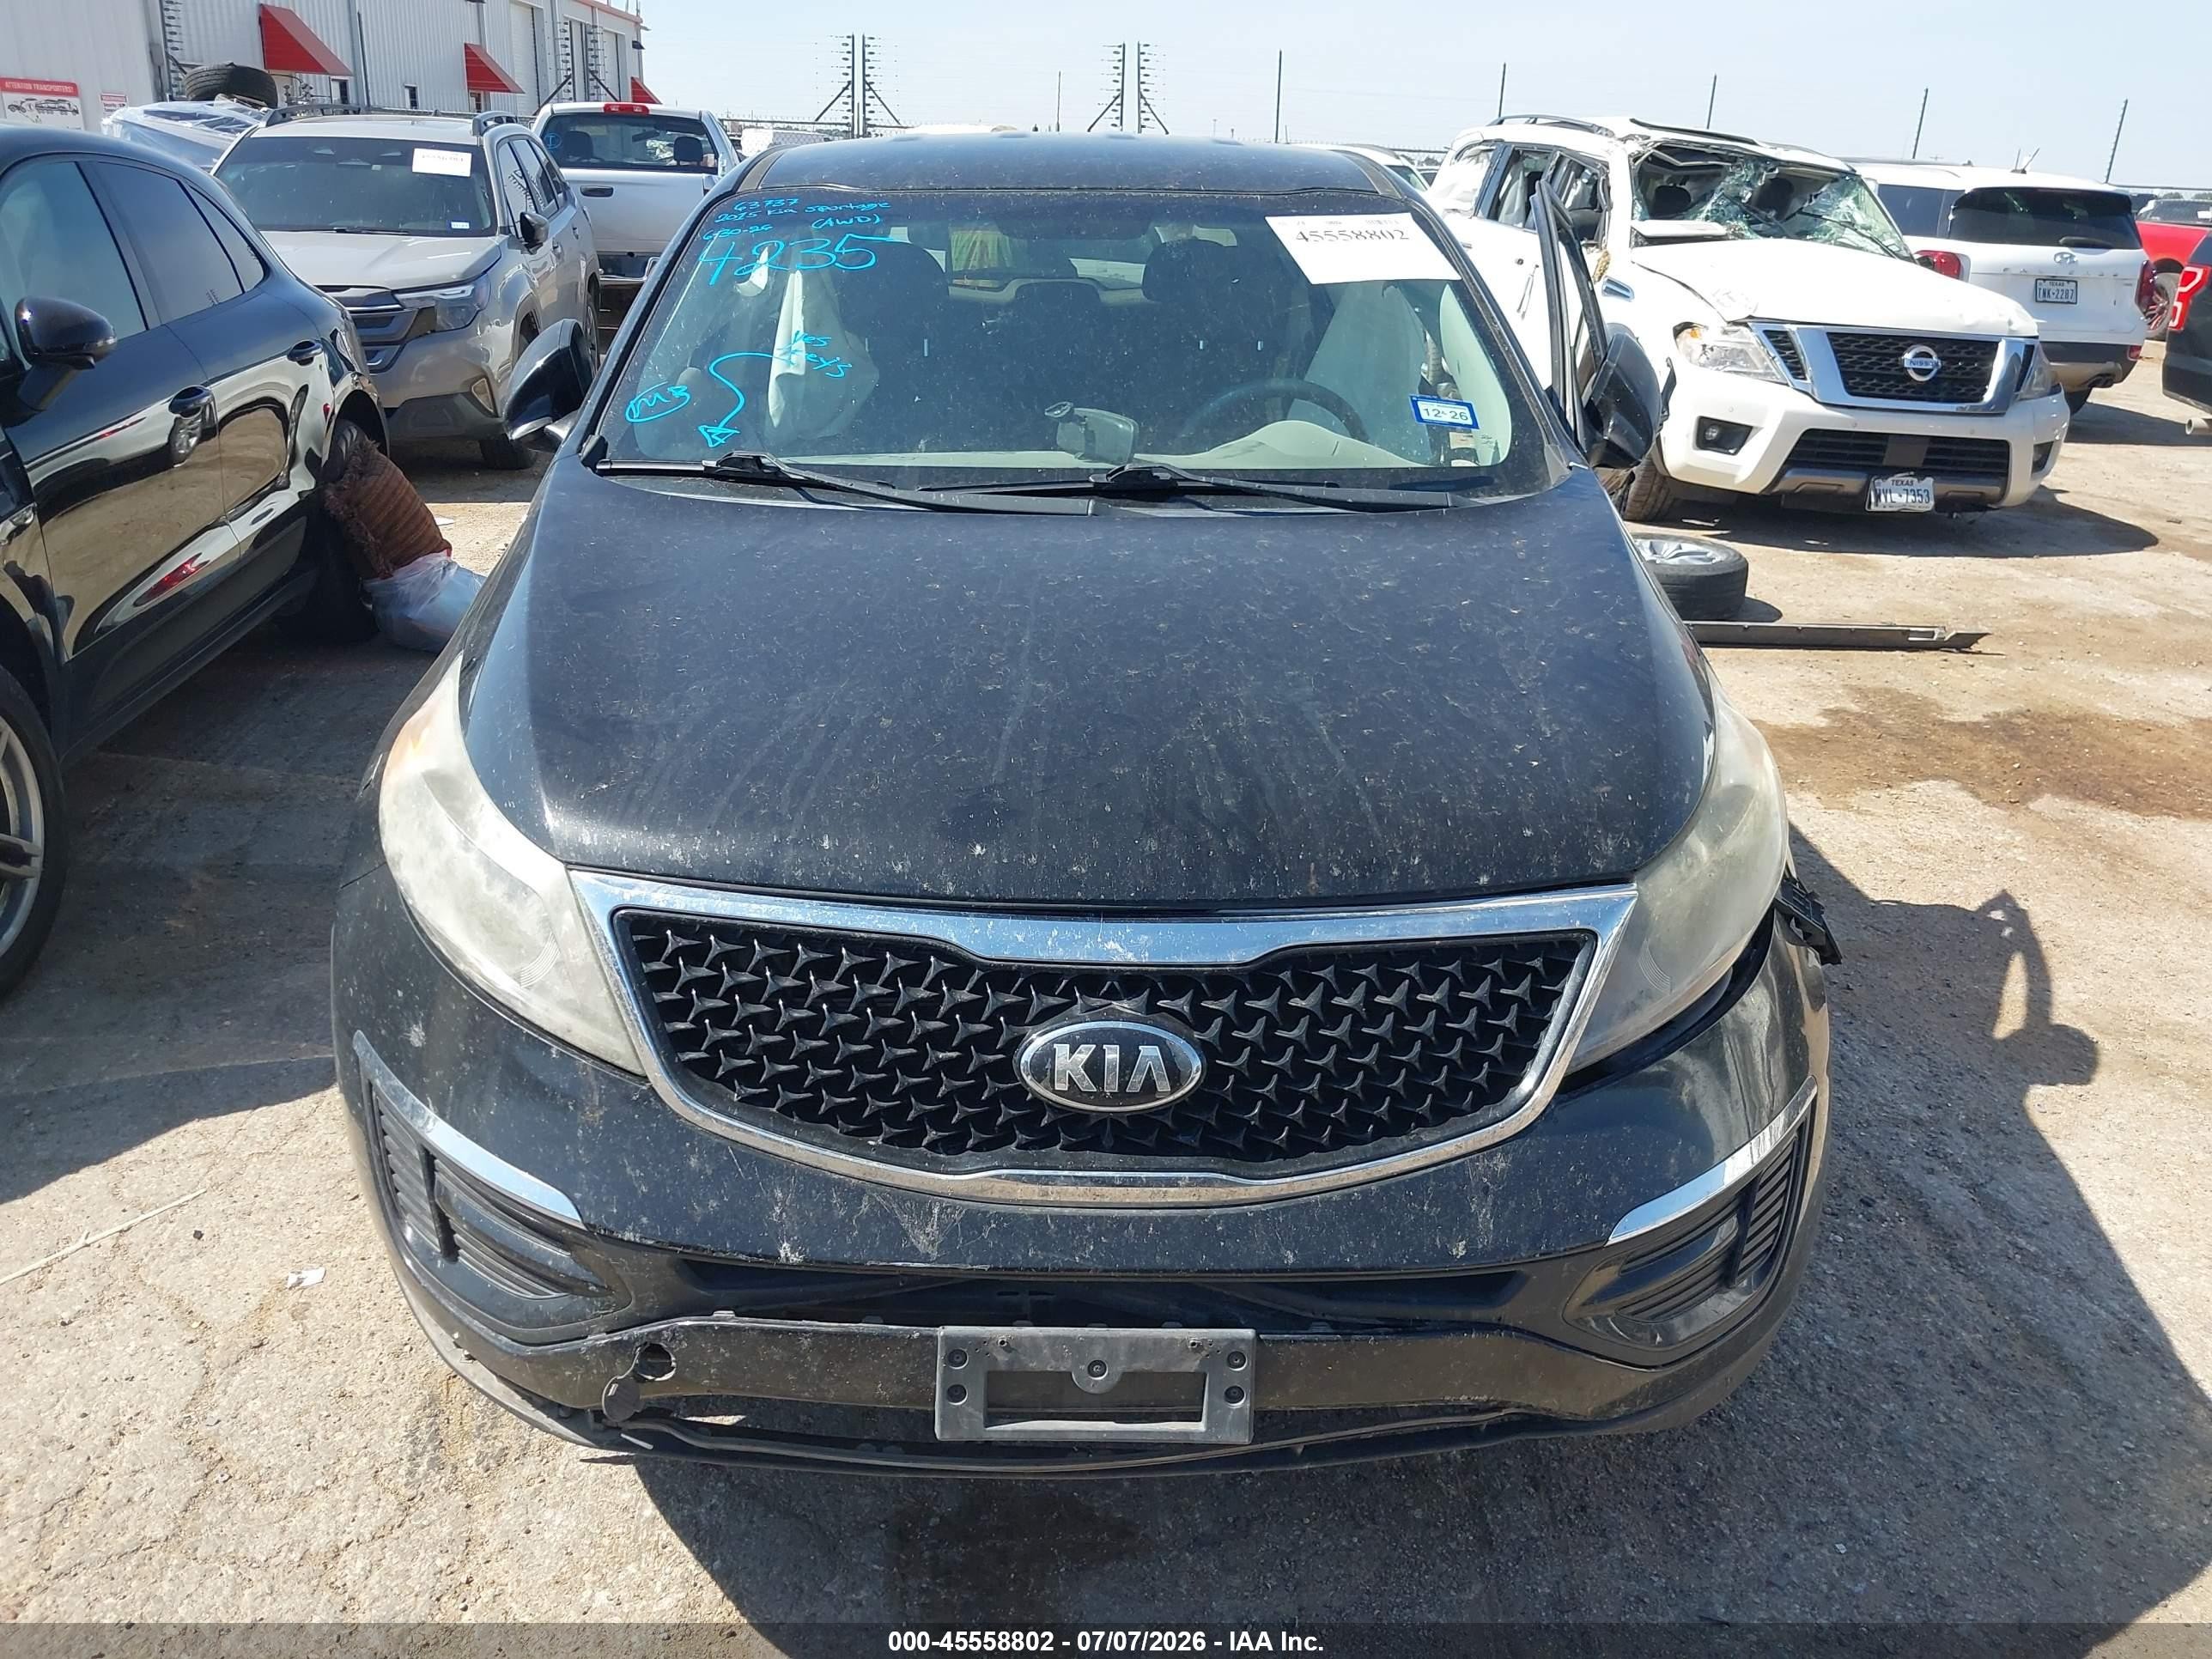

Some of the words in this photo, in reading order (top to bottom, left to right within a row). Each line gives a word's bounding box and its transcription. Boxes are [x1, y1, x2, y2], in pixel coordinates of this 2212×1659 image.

[1295, 228, 1411, 243] 45558802
[698, 233, 895, 286] 4235
[1423, 408, 1442, 418] 12
[1449, 410, 1468, 421] 26
[1054, 1043, 1171, 1092] KIA
